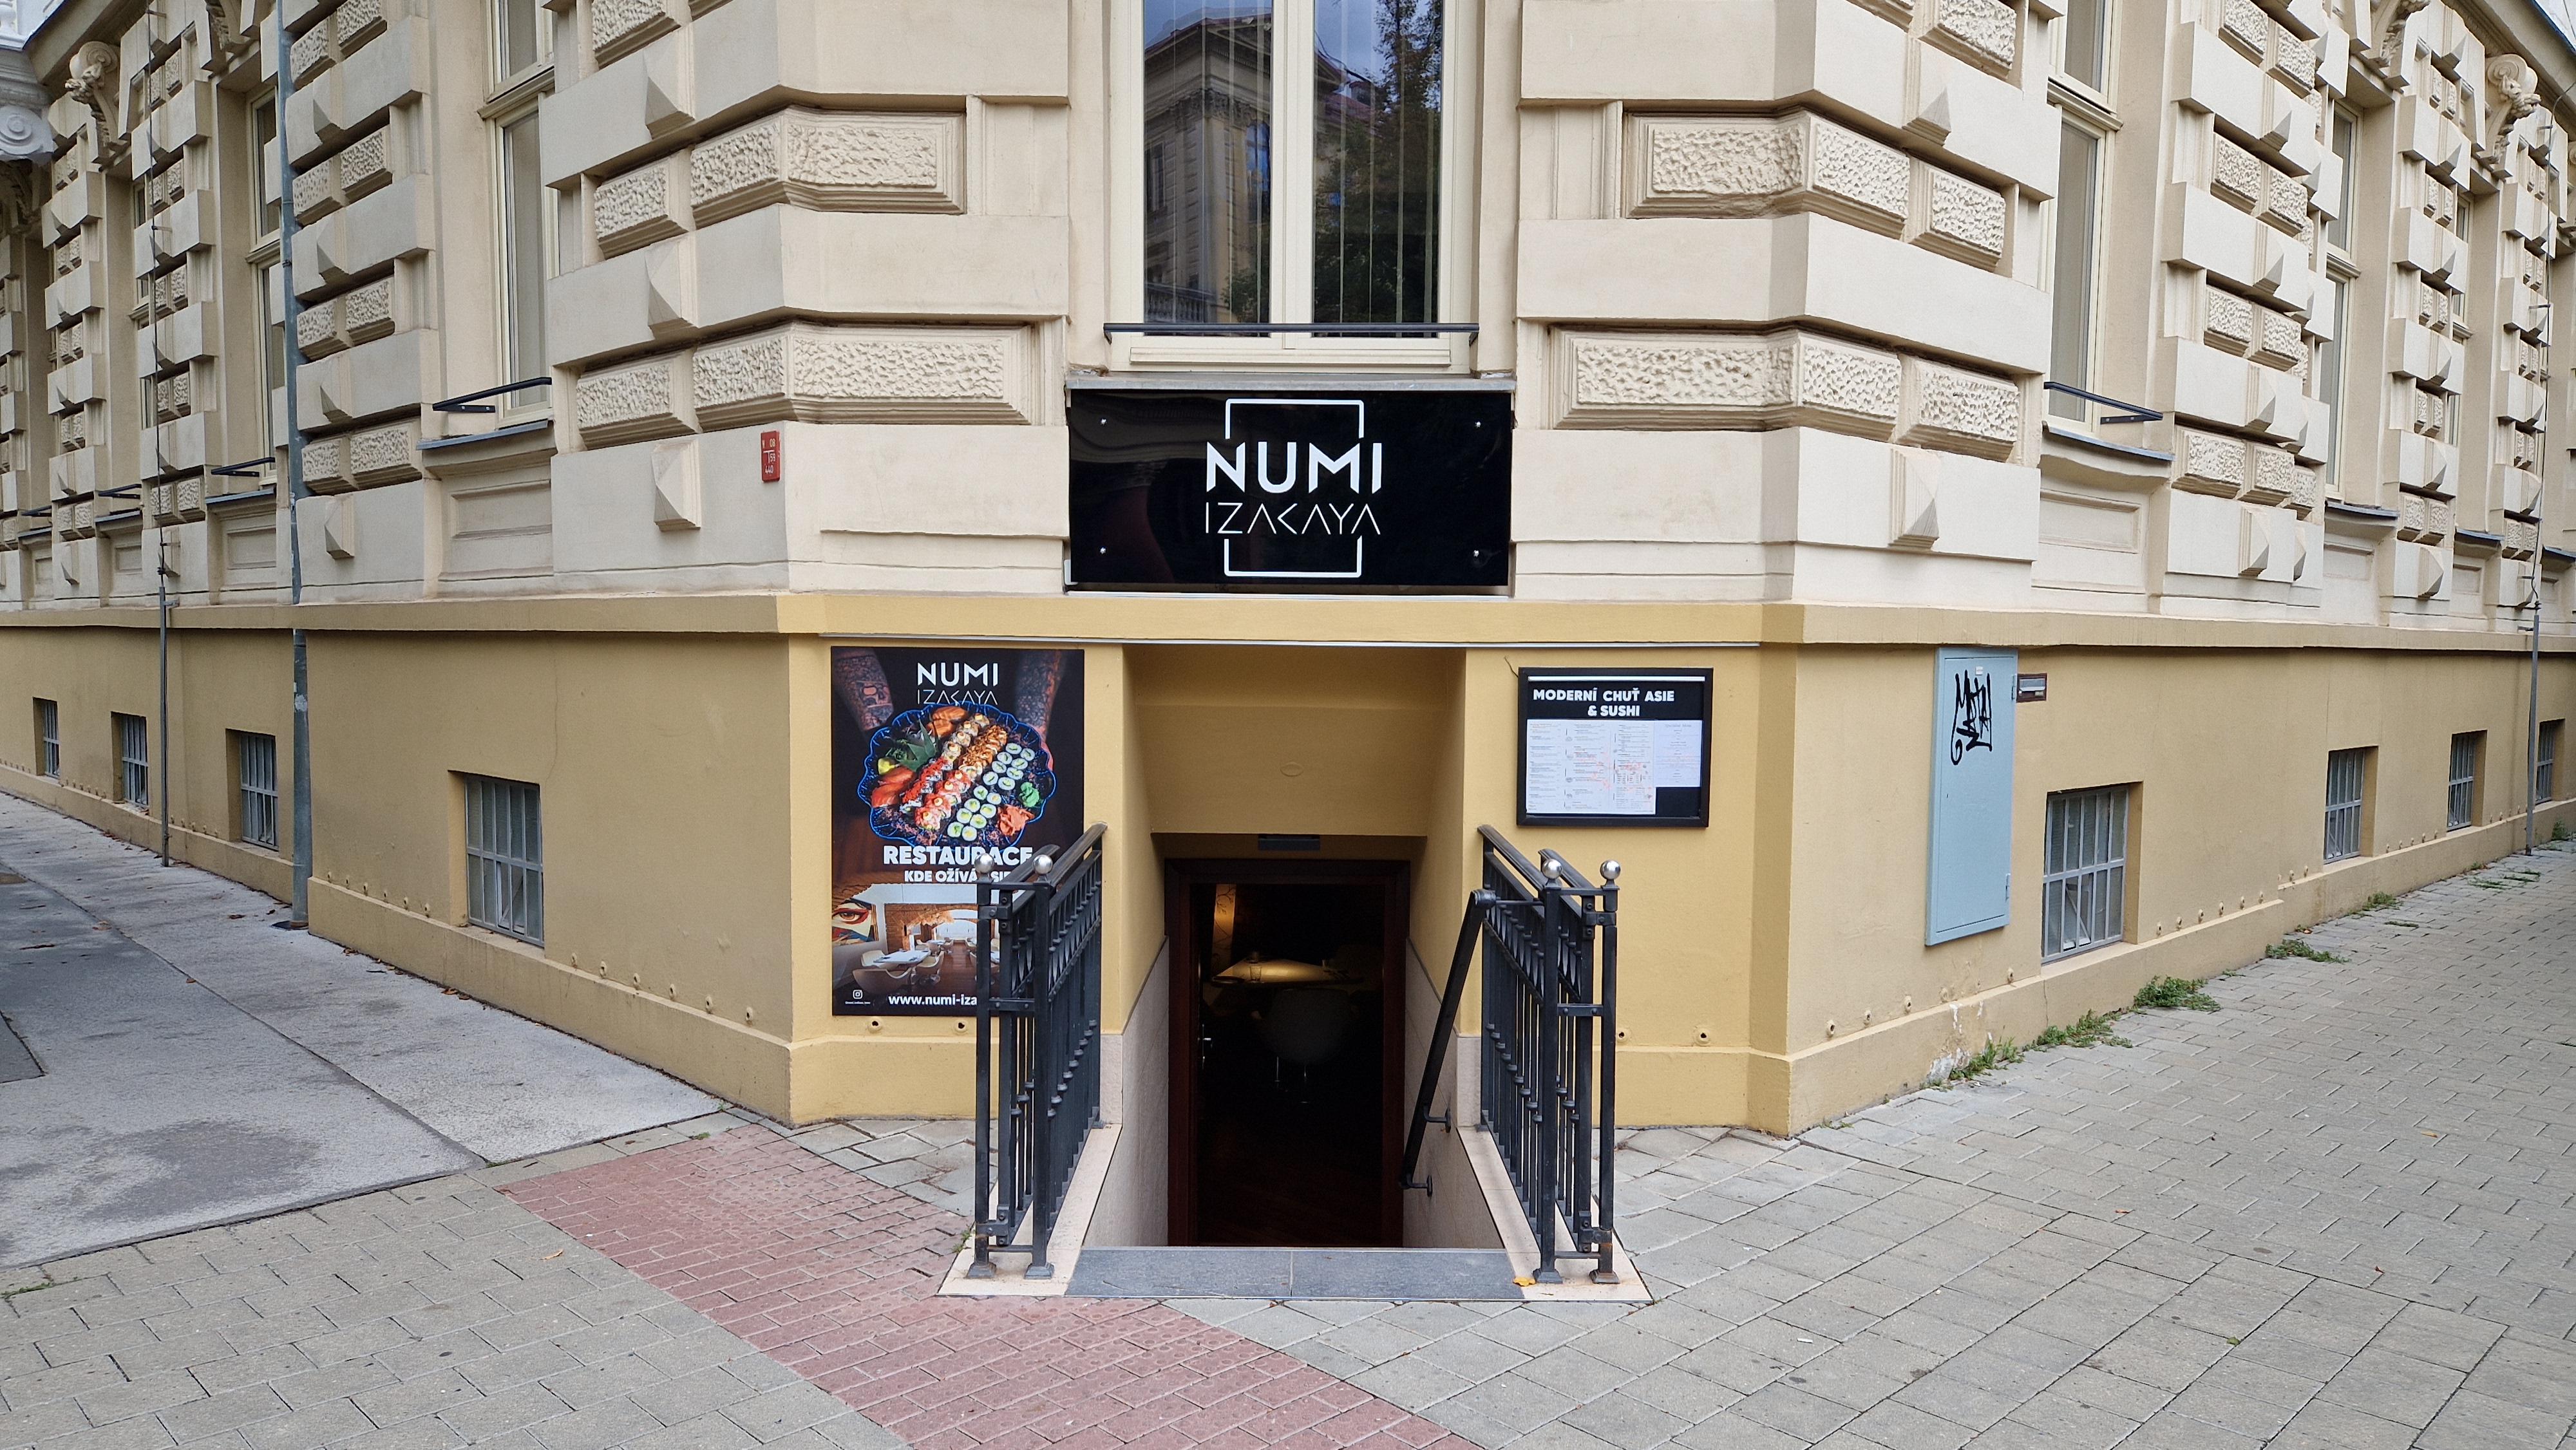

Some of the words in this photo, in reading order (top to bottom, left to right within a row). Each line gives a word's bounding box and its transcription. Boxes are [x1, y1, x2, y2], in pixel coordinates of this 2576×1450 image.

[1206, 440, 1382, 494] NUMI
[917, 662, 998, 686] NUMI
[1533, 687, 1598, 702] MODERNÍ
[1602, 687, 1640, 702] CHUŤ
[1644, 690, 1675, 702] ASIE
[1587, 705, 1597, 716] &
[1600, 705, 1640, 717] SUSHI
[904, 871, 933, 882] KDE
[935, 867, 978, 883] OŽÍVÁ
[888, 993, 978, 1006] www.numi-iza
